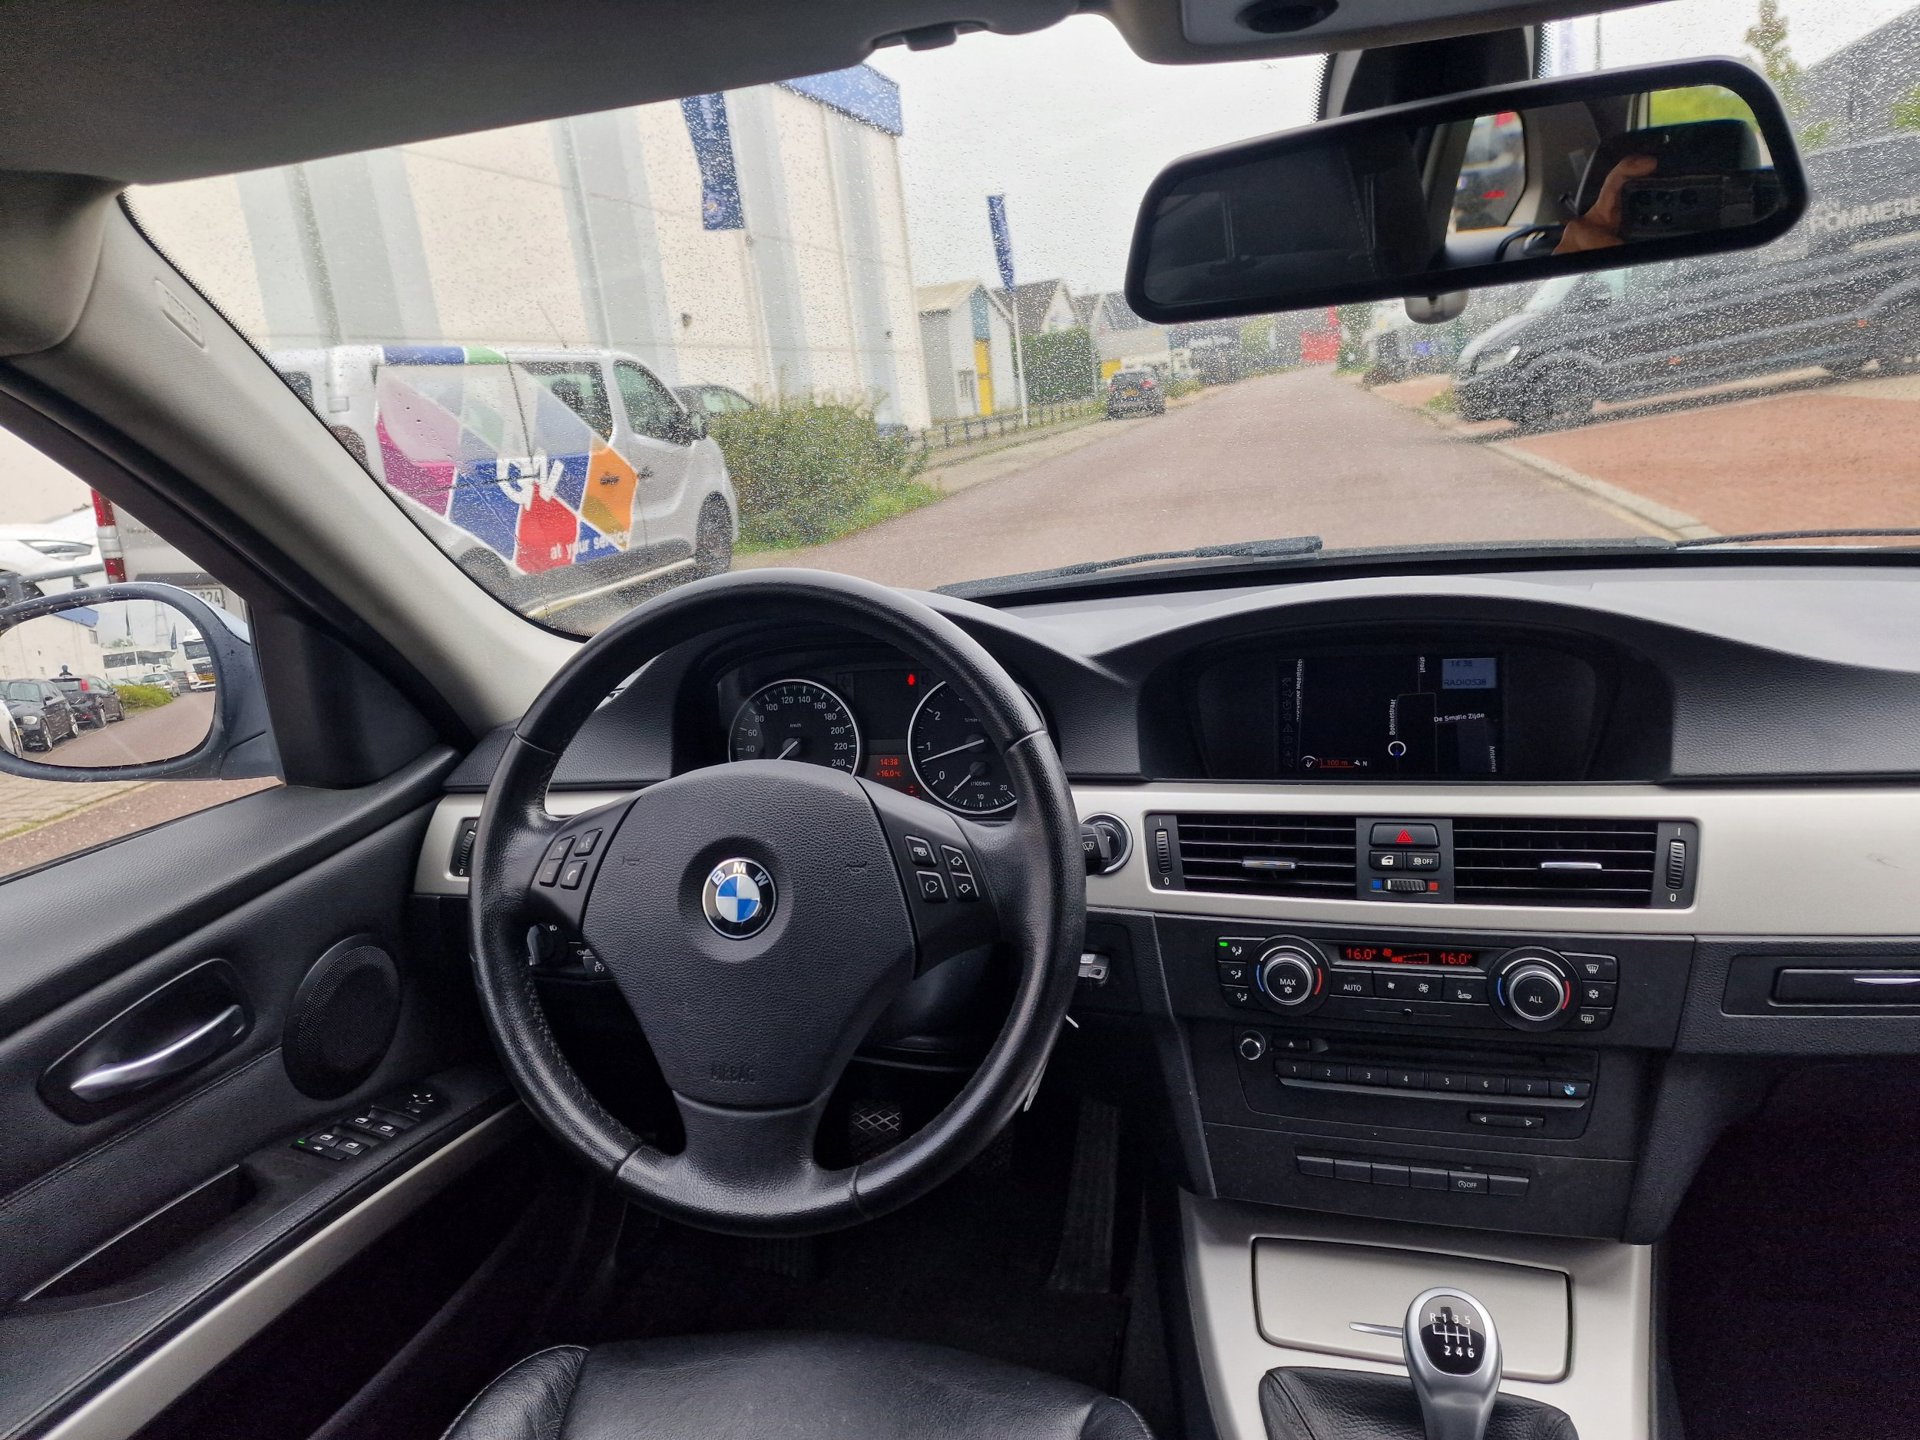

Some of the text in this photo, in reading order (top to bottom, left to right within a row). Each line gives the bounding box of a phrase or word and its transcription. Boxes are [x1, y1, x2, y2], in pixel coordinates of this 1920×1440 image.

[781, 696, 794, 704] 120
[798, 696, 811, 704] 140
[765, 703, 778, 711] 100
[813, 701, 827, 710] 160
[754, 715, 765, 723] 80
[823, 712, 837, 721] 180
[934, 711, 941, 721] 2
[747, 729, 758, 737] 60
[830, 726, 845, 735] 200
[745, 745, 755, 753] 40
[834, 742, 848, 751] 220
[925, 741, 931, 751] 1
[831, 758, 846, 767] 240
[880, 758, 898, 766] 14:38
[938, 770, 945, 780] 0
[711, 861, 769, 887] BMW
[1164, 877, 1170, 886] 0
[1669, 893, 1677, 903] 0
[1279, 978, 1296, 986] MAX
[1343, 983, 1362, 992] AUTO
[1529, 995, 1543, 1004] ALL
[1293, 1065, 1297, 1073] 1
[1326, 1069, 1331, 1077] 2
[1430, 1313, 1471, 1325] R 1 3 5
[1445, 1346, 1475, 1358] 2 4 6
